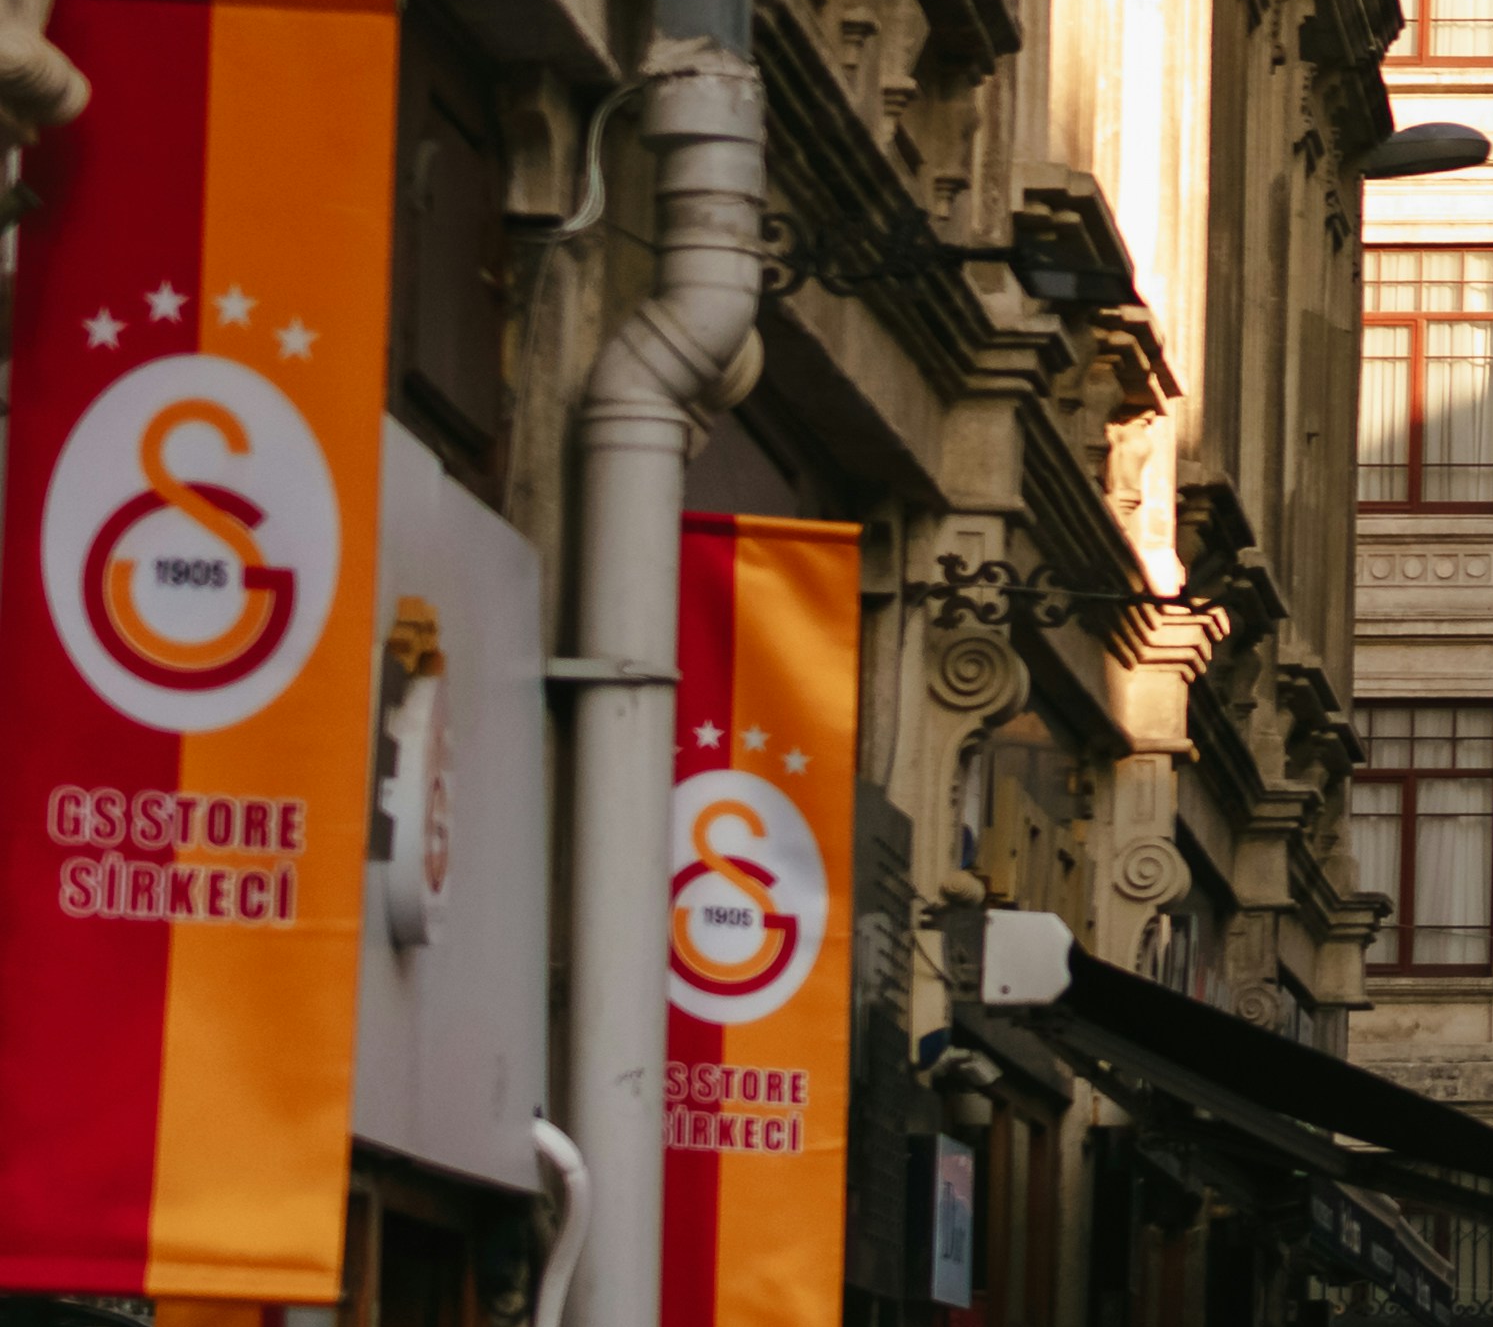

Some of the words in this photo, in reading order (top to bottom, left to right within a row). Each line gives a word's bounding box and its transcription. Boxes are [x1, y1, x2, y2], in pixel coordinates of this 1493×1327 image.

[154, 557, 230, 589] 1905
[129, 789, 308, 857] STORE
[703, 905, 754, 929] 1905
